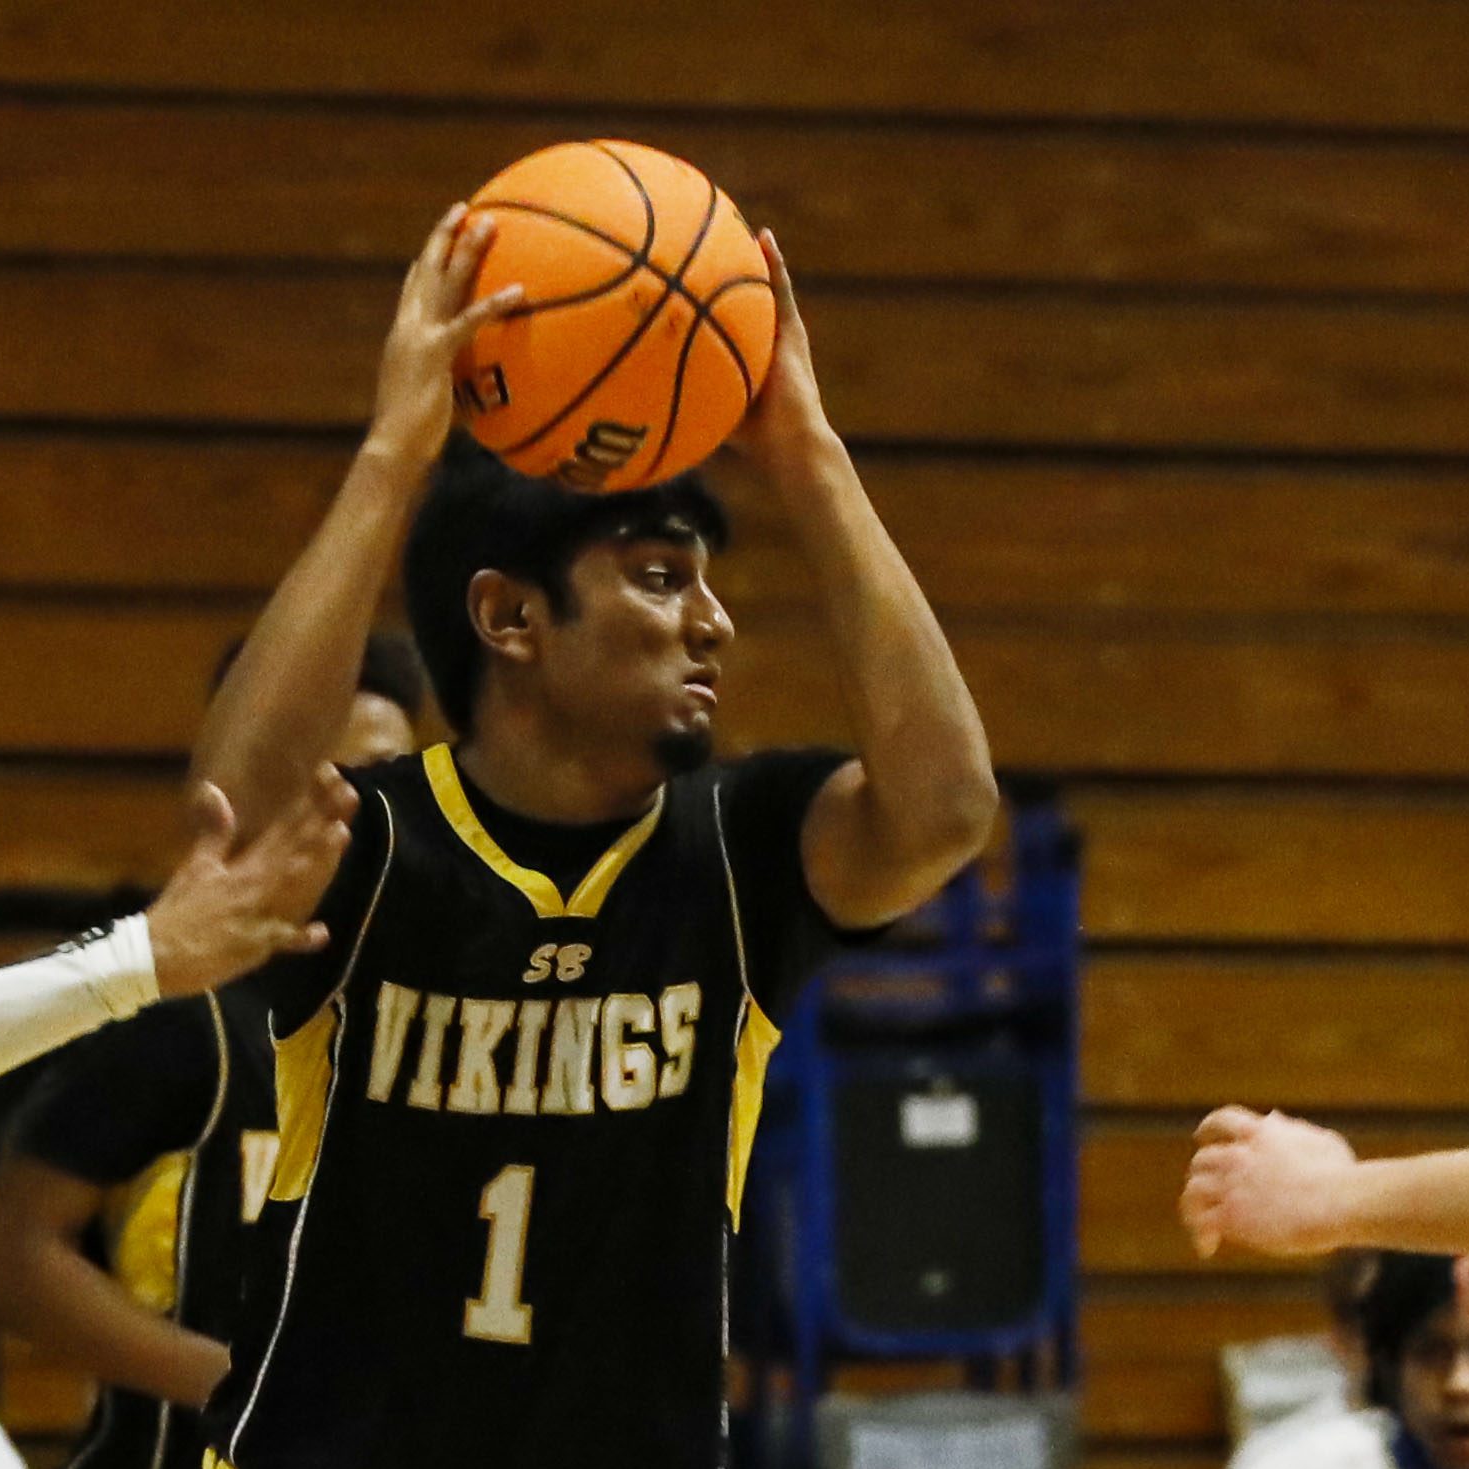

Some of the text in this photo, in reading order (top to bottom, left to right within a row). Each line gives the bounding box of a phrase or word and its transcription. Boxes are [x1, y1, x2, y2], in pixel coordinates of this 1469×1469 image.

[522, 943, 593, 983] SB
[365, 980, 701, 1116] VIKINGS
[462, 1163, 535, 1345] 1
